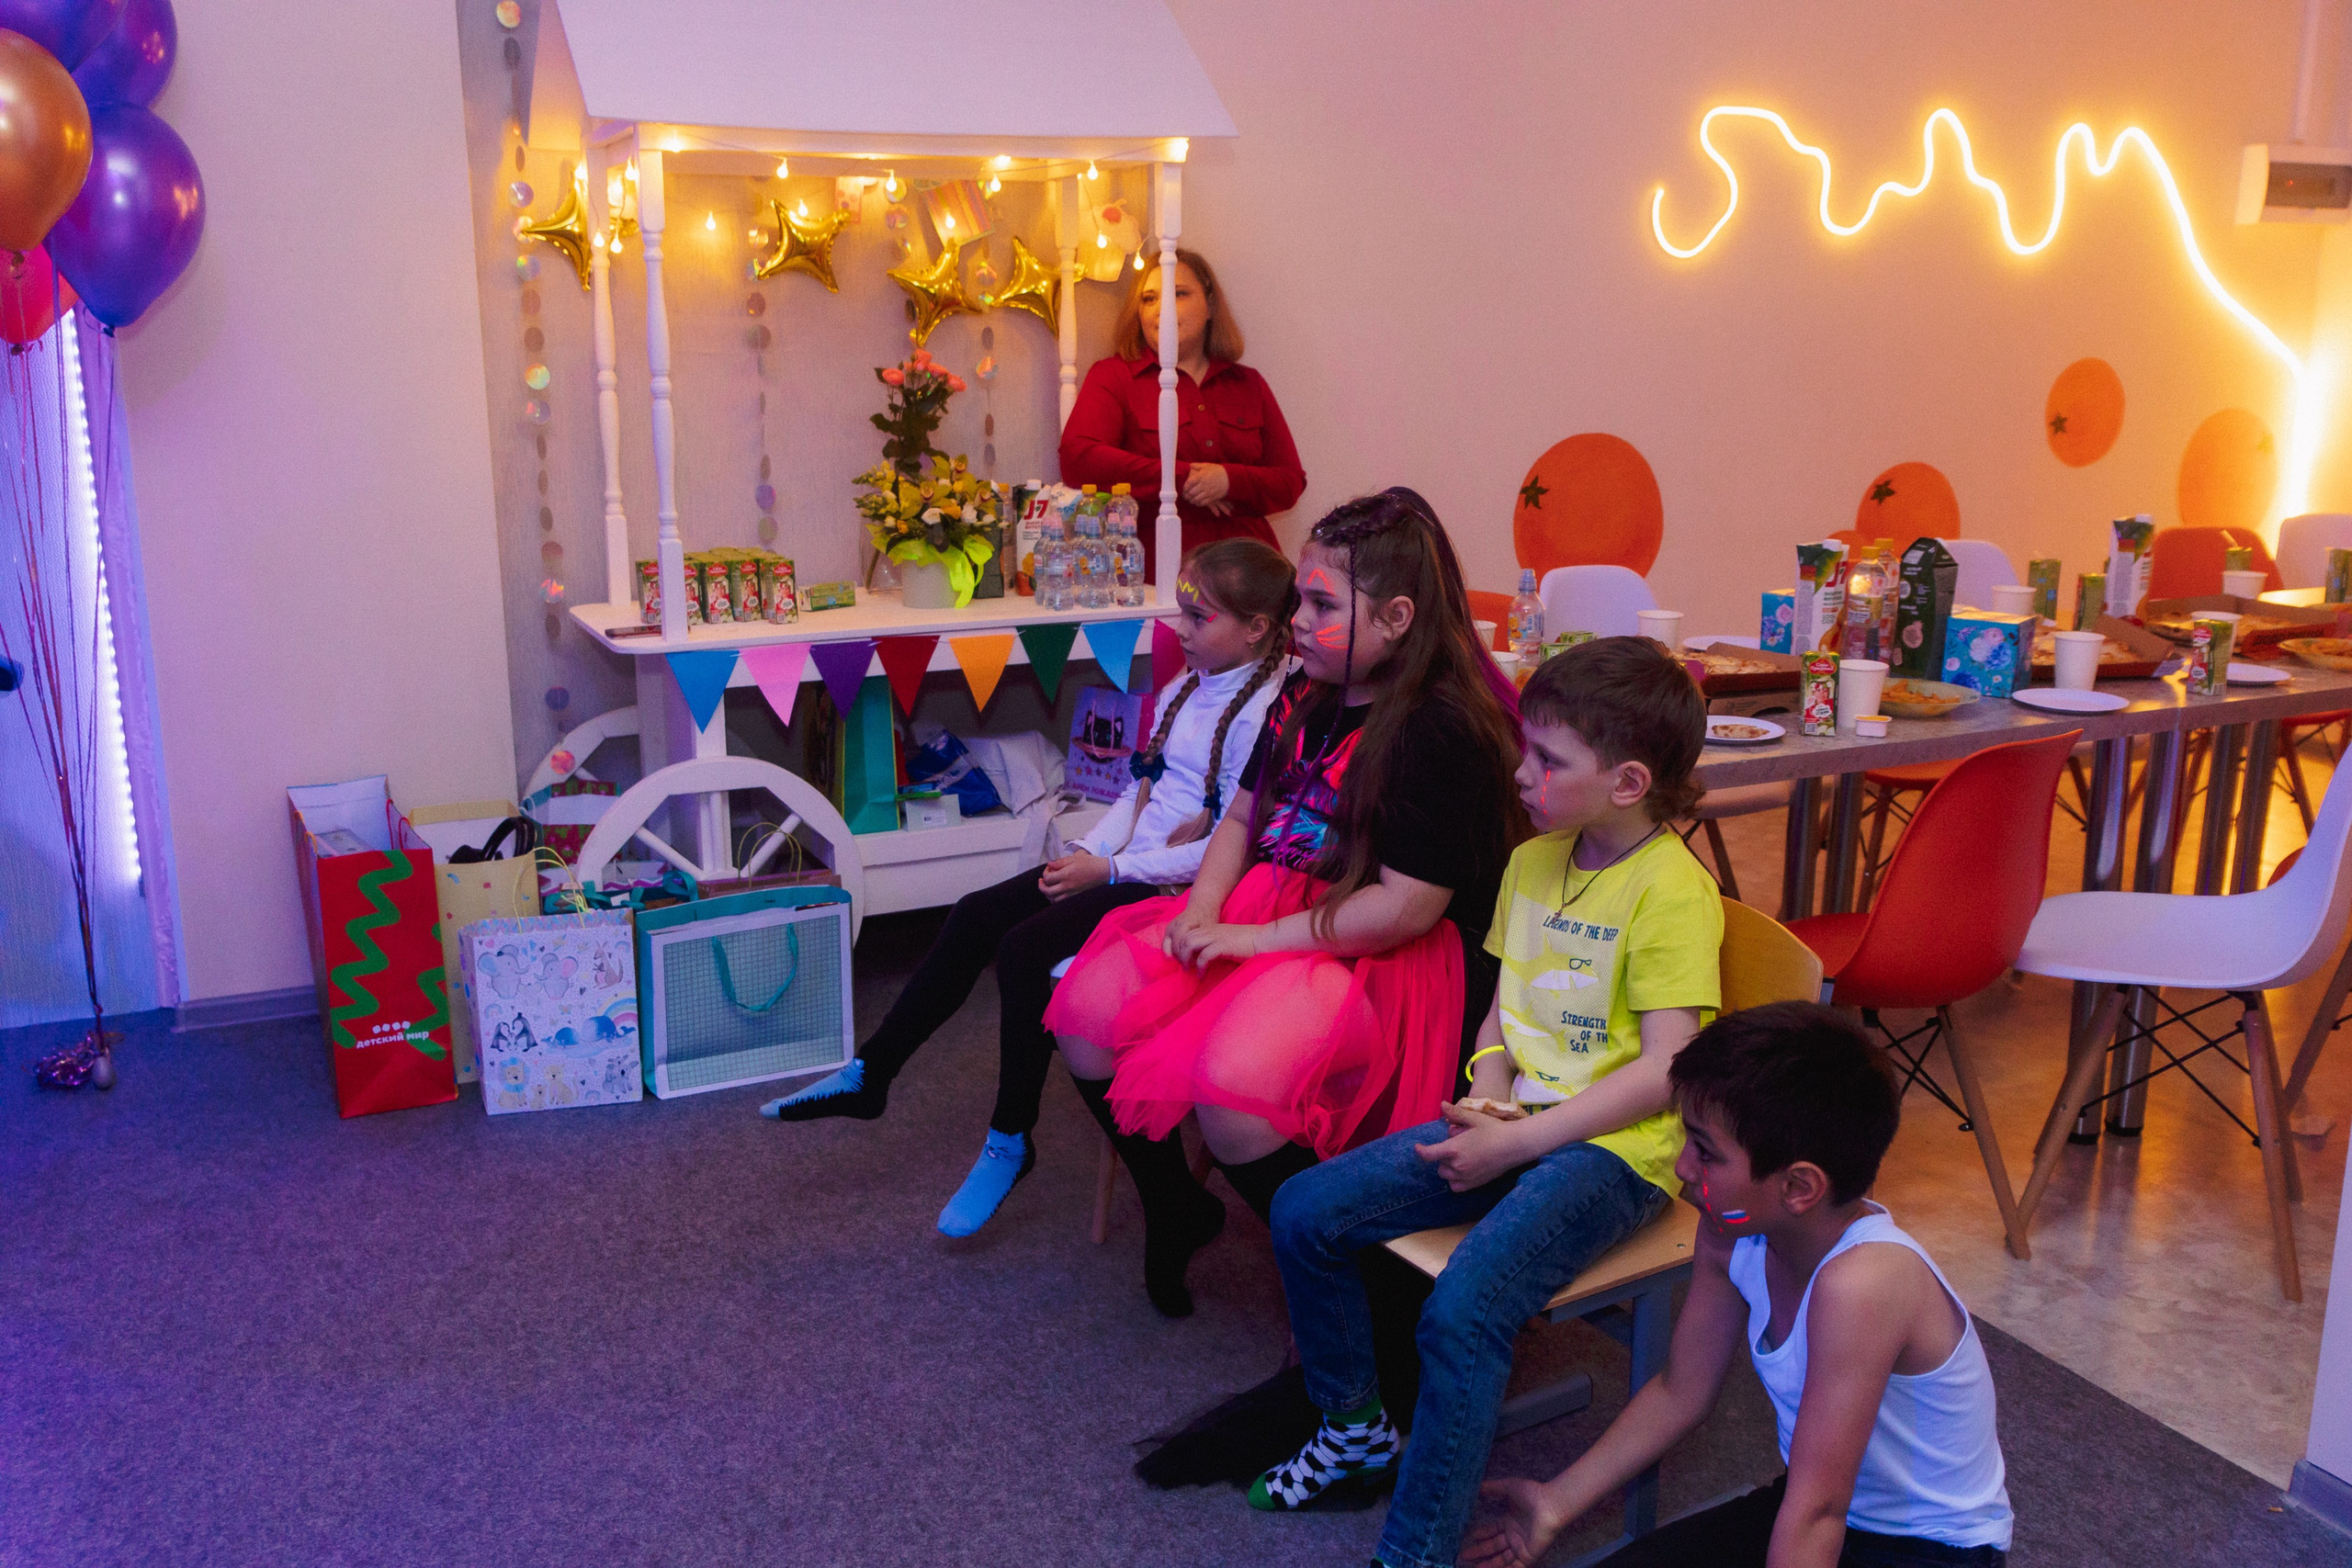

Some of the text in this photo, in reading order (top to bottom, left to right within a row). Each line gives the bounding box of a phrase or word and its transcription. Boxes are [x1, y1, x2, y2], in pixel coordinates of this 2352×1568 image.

[1023, 500, 1049, 520] J7
[1571, 921, 1583, 935] OF
[1584, 924, 1600, 940] THE
[1602, 927, 1619, 942] DEEP
[1561, 1010, 1606, 1030] STRENGTH
[356, 1031, 429, 1049] детский мир
[1580, 1030, 1608, 1043] OF TH
[1570, 1039, 1589, 1054] SEA
